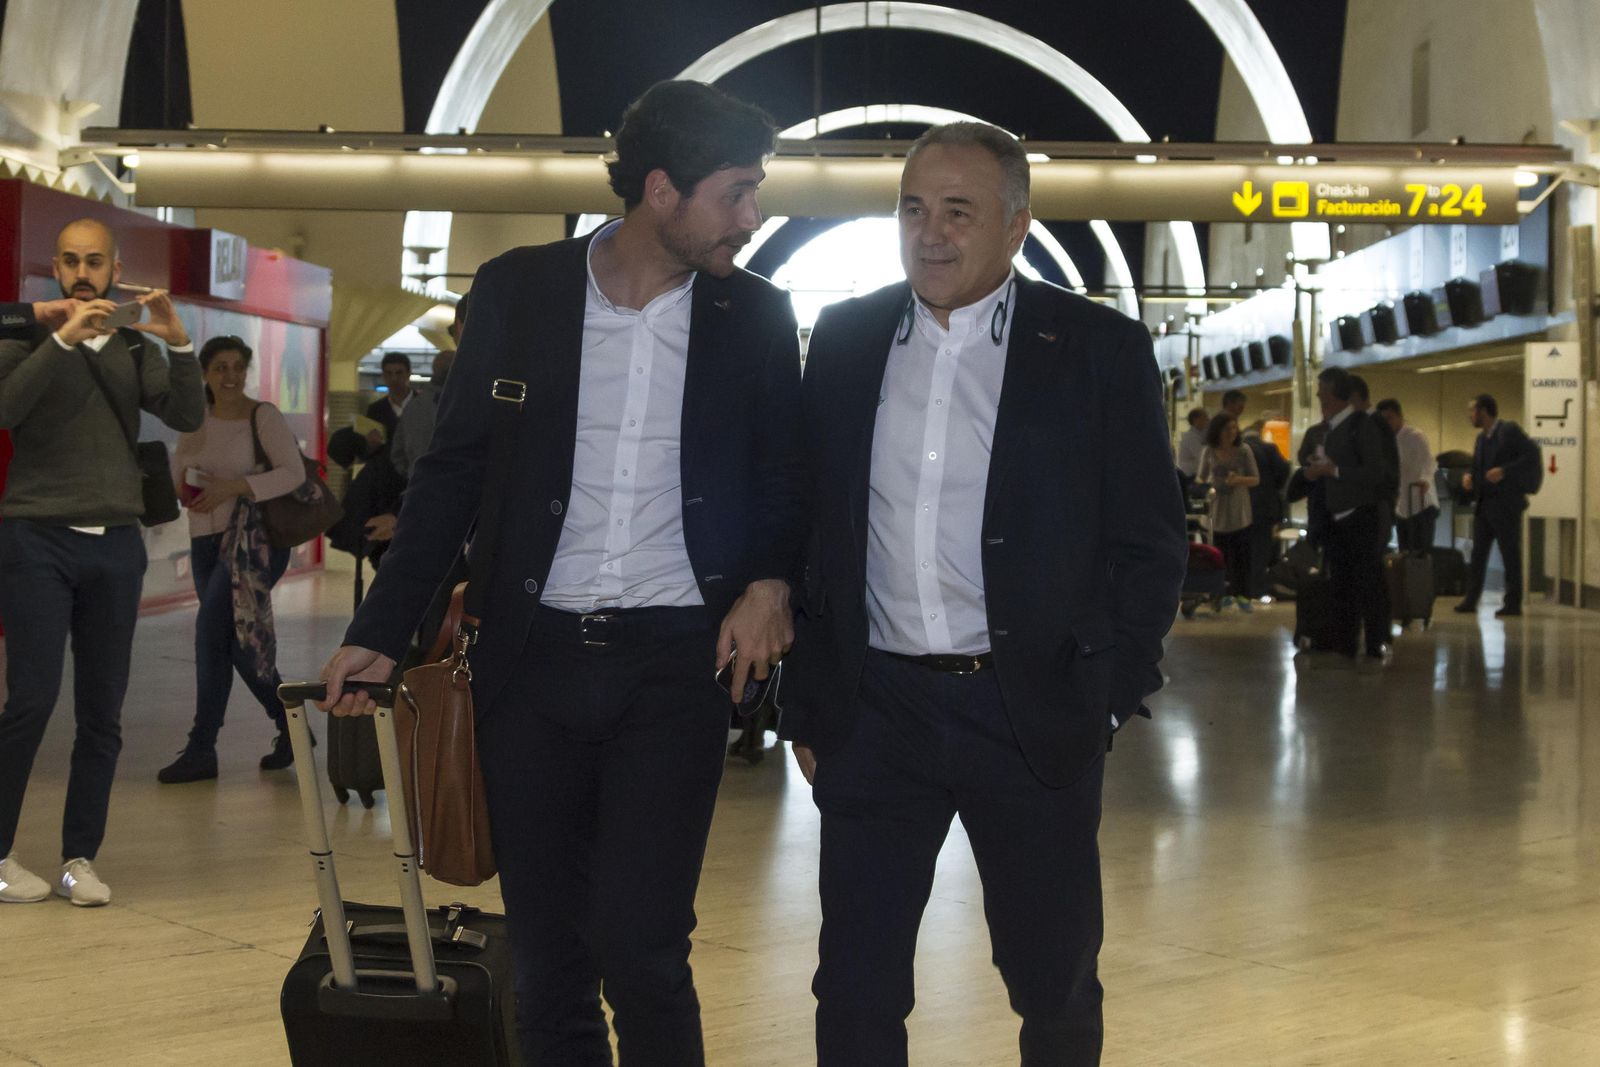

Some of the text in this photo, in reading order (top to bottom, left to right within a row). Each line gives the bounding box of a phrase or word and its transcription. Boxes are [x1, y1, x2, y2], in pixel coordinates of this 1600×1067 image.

[1316, 183, 1370, 197] Check-in
[1405, 183, 1487, 217] 7 to 24
[1316, 199, 1401, 216] Facturación
[1428, 204, 1439, 216] a
[1532, 378, 1578, 388] CARRITOS
[1533, 437, 1577, 446] ROLLEYS
